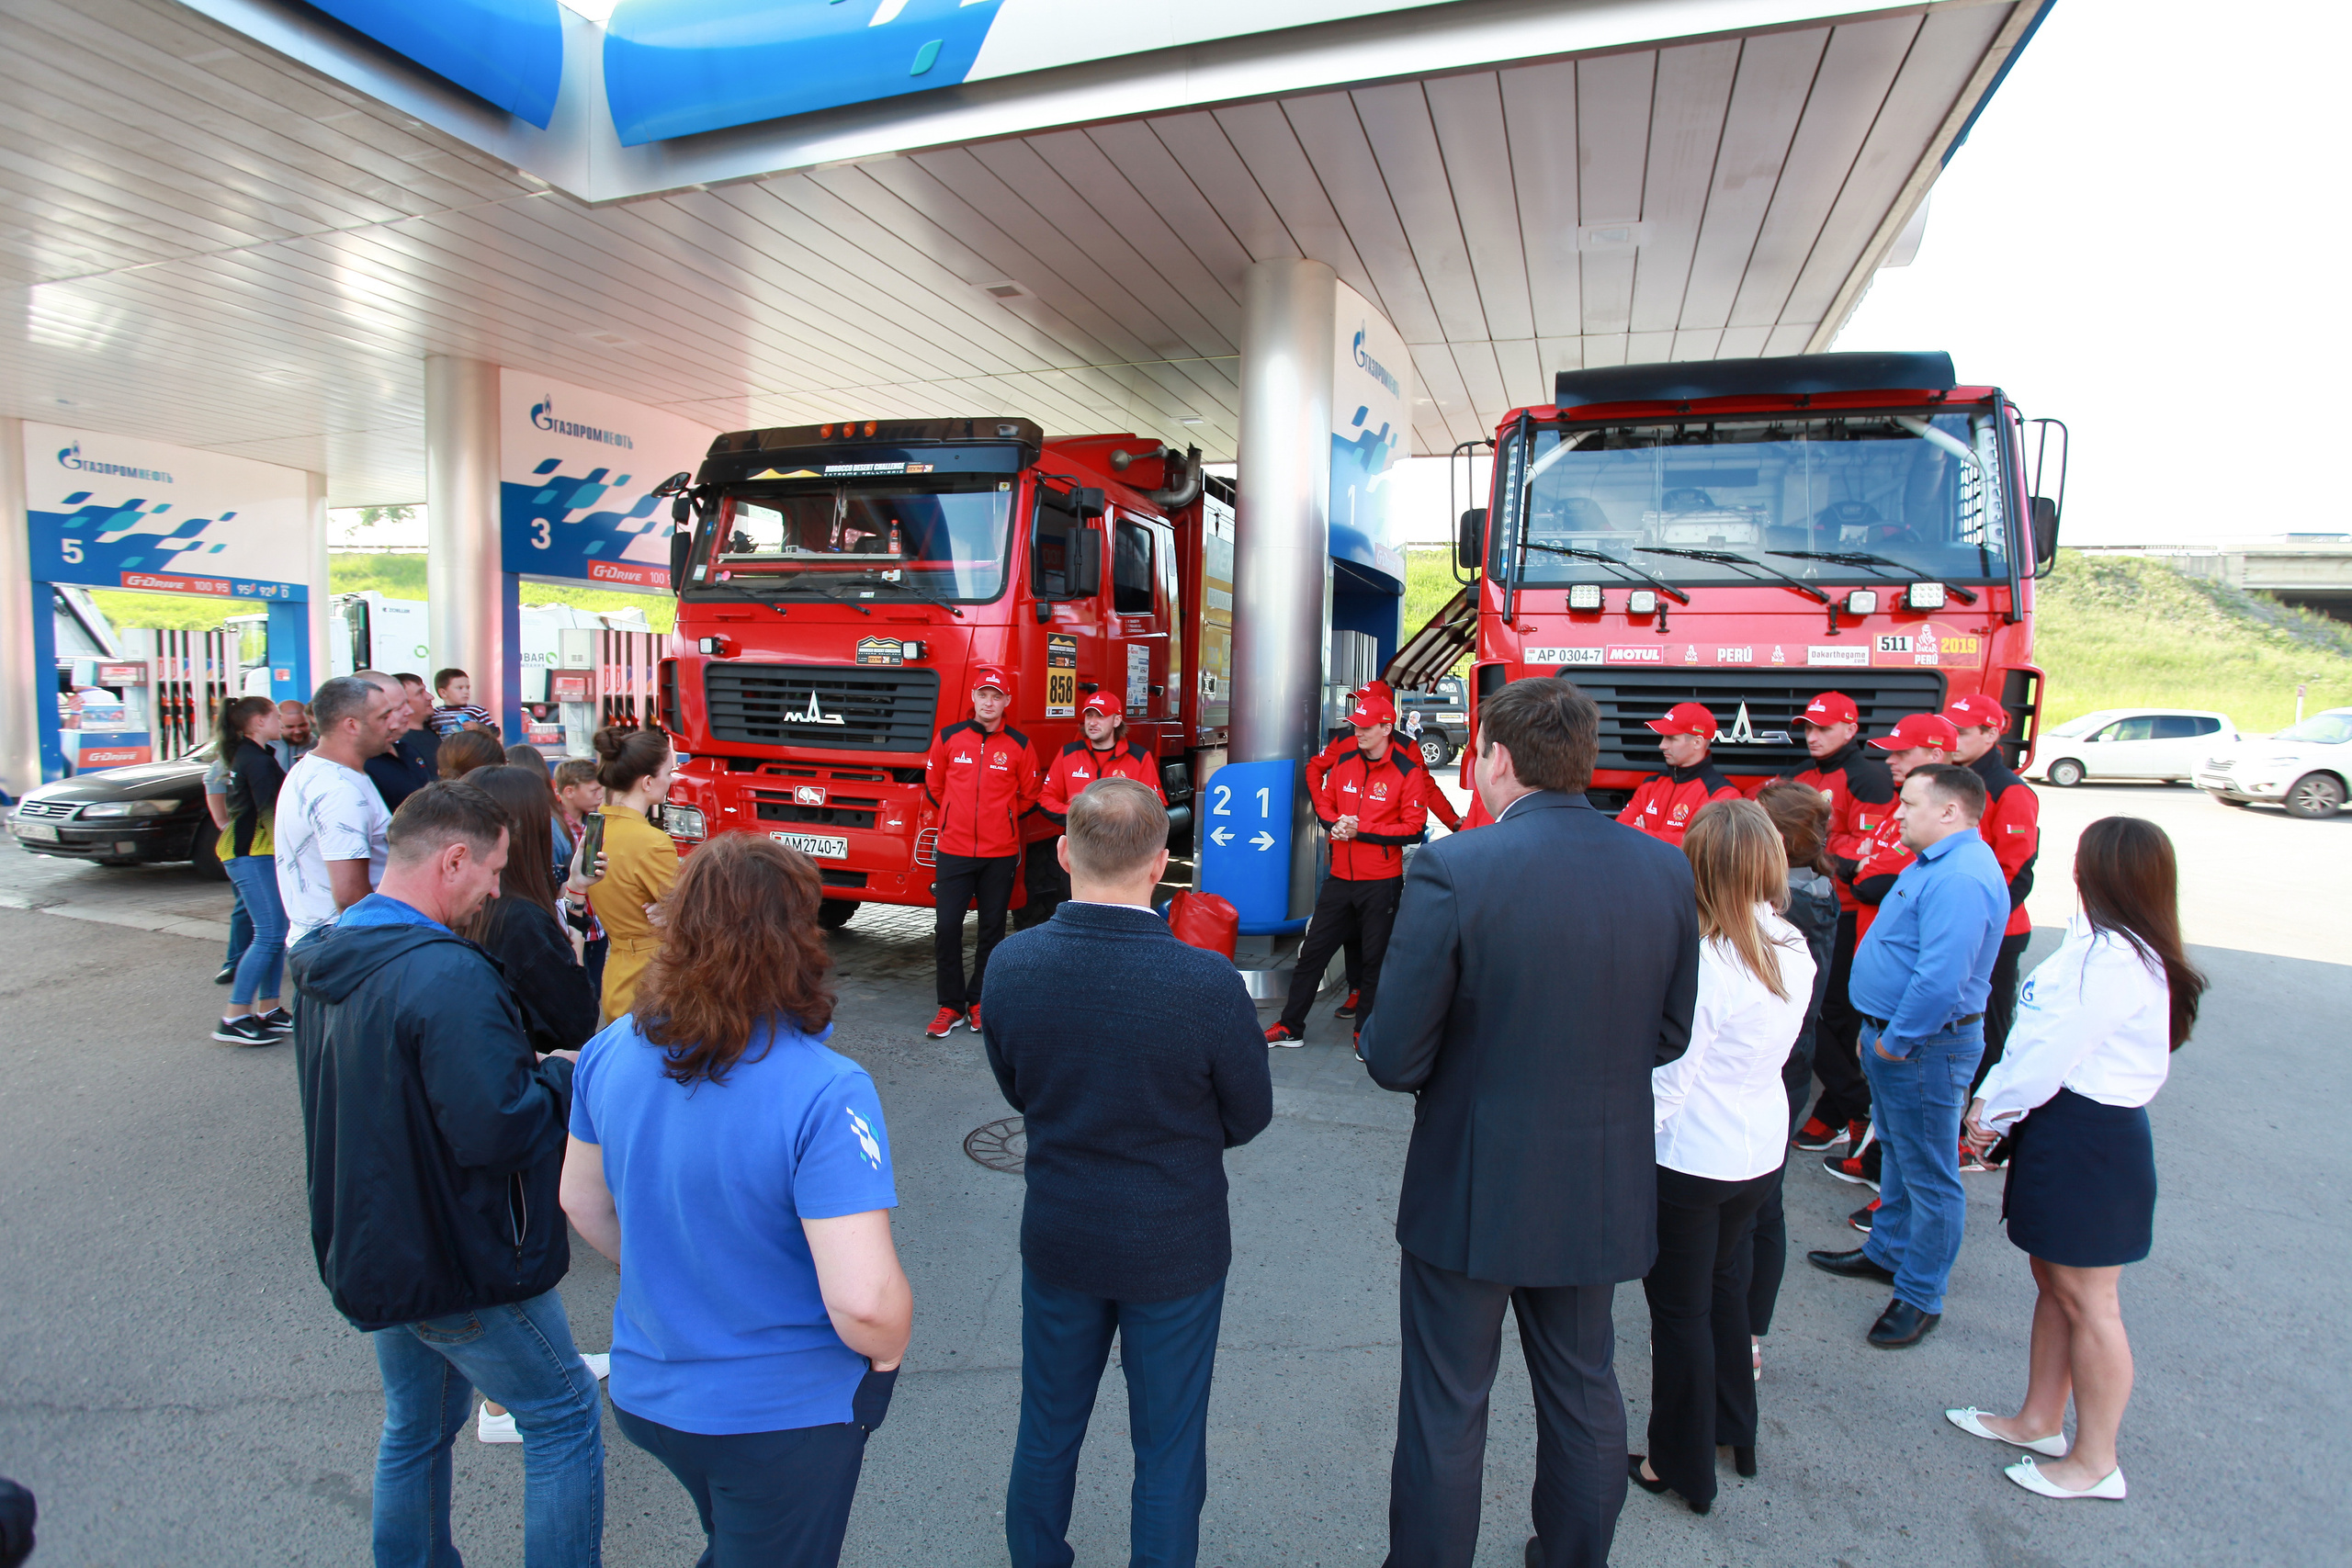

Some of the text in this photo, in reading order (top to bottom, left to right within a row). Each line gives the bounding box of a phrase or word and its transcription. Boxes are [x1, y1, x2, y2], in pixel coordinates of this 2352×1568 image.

[553, 418, 633, 449] ГАЗПРОМНЕФТЬ
[853, 463, 875, 472] DESERT
[874, 462, 905, 470] CHALLENGE
[1347, 484, 1356, 525] 1
[530, 517, 551, 550] 3
[61, 537, 85, 564] 5
[650, 571, 665, 584] 100
[194, 581, 212, 592] 100
[215, 582, 229, 592] 95
[237, 584, 250, 595] 95
[259, 586, 272, 597] 92
[1881, 636, 1907, 651] 511
[1940, 637, 1977, 654] 2019
[520, 653, 545, 662] ВАЯ
[1537, 649, 1601, 661] AP 0304-7
[1609, 649, 1660, 661] MOTUL
[1717, 646, 1753, 662] PERÚ
[1811, 650, 1866, 660] Dakarthegame
[1049, 674, 1073, 705] 858
[1213, 784, 1270, 818] 2 1
